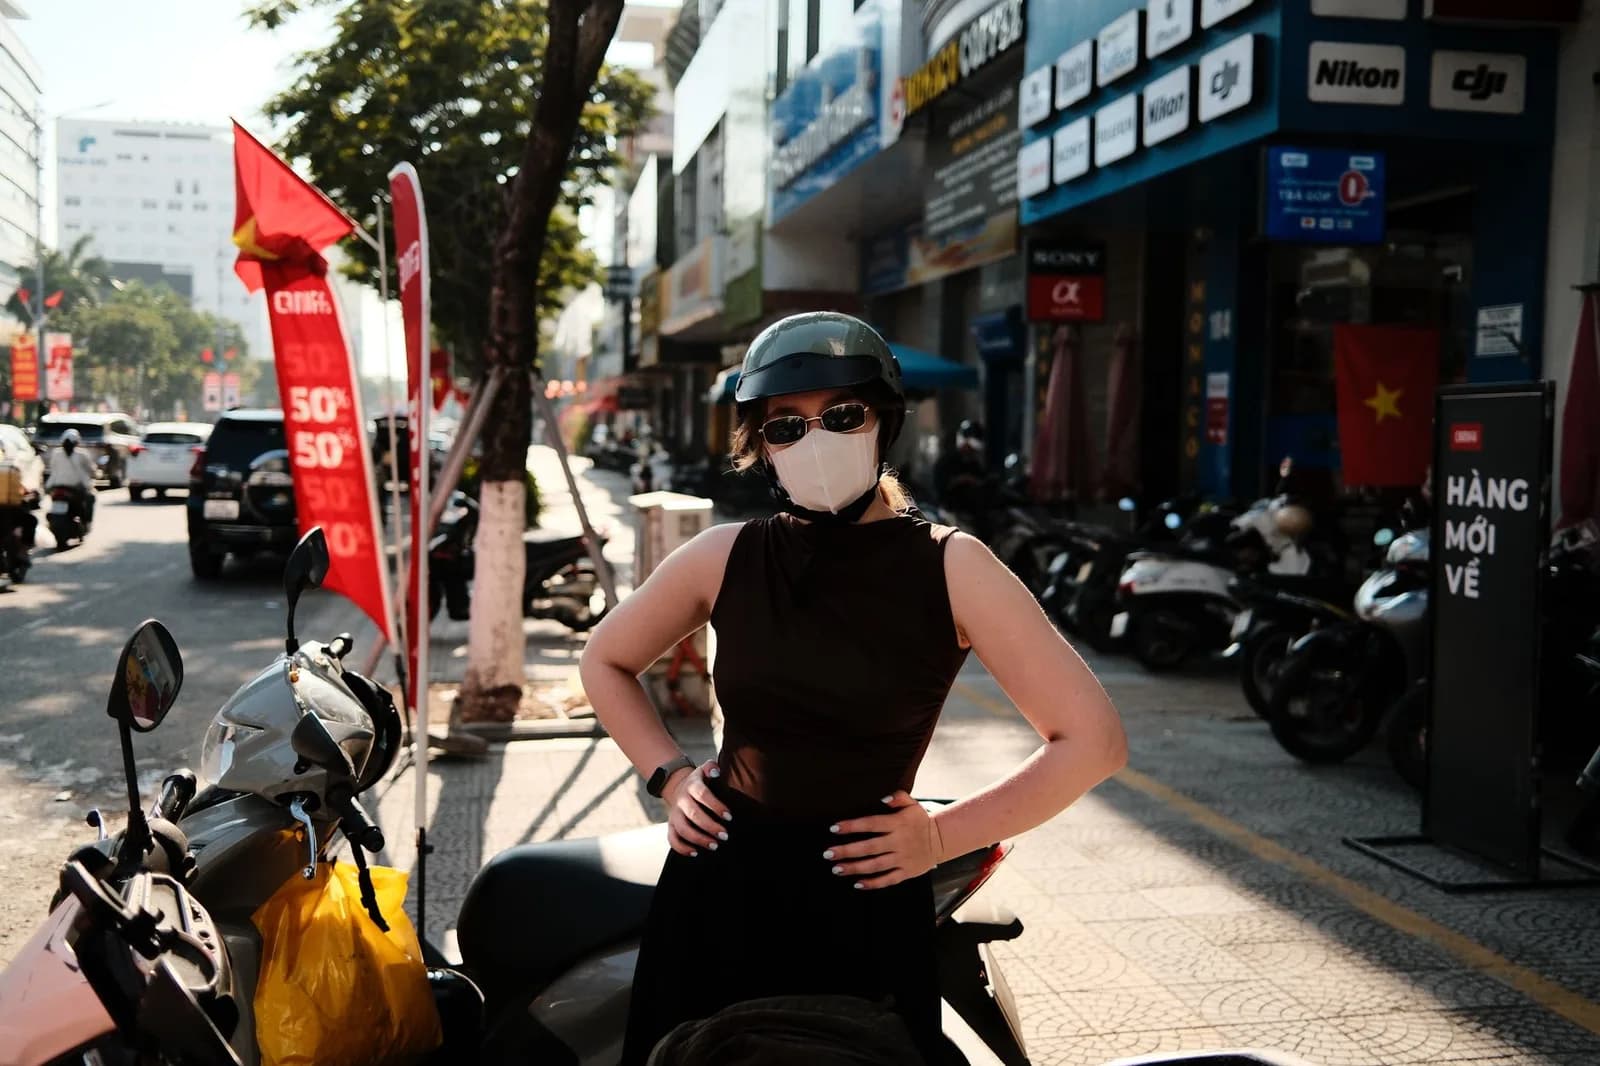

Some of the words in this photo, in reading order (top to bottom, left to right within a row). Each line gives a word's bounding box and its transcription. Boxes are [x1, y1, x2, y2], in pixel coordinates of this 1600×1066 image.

[1208, 59, 1239, 101] dji
[1315, 59, 1400, 89] Nikon
[1452, 64, 1508, 101] dji
[1147, 90, 1185, 124] Nikon
[1032, 249, 1100, 267] SONY
[290, 386, 351, 423] 50%
[295, 427, 357, 468] 50%
[1446, 469, 1529, 512] HÀNG
[1445, 514, 1496, 555] MỚI
